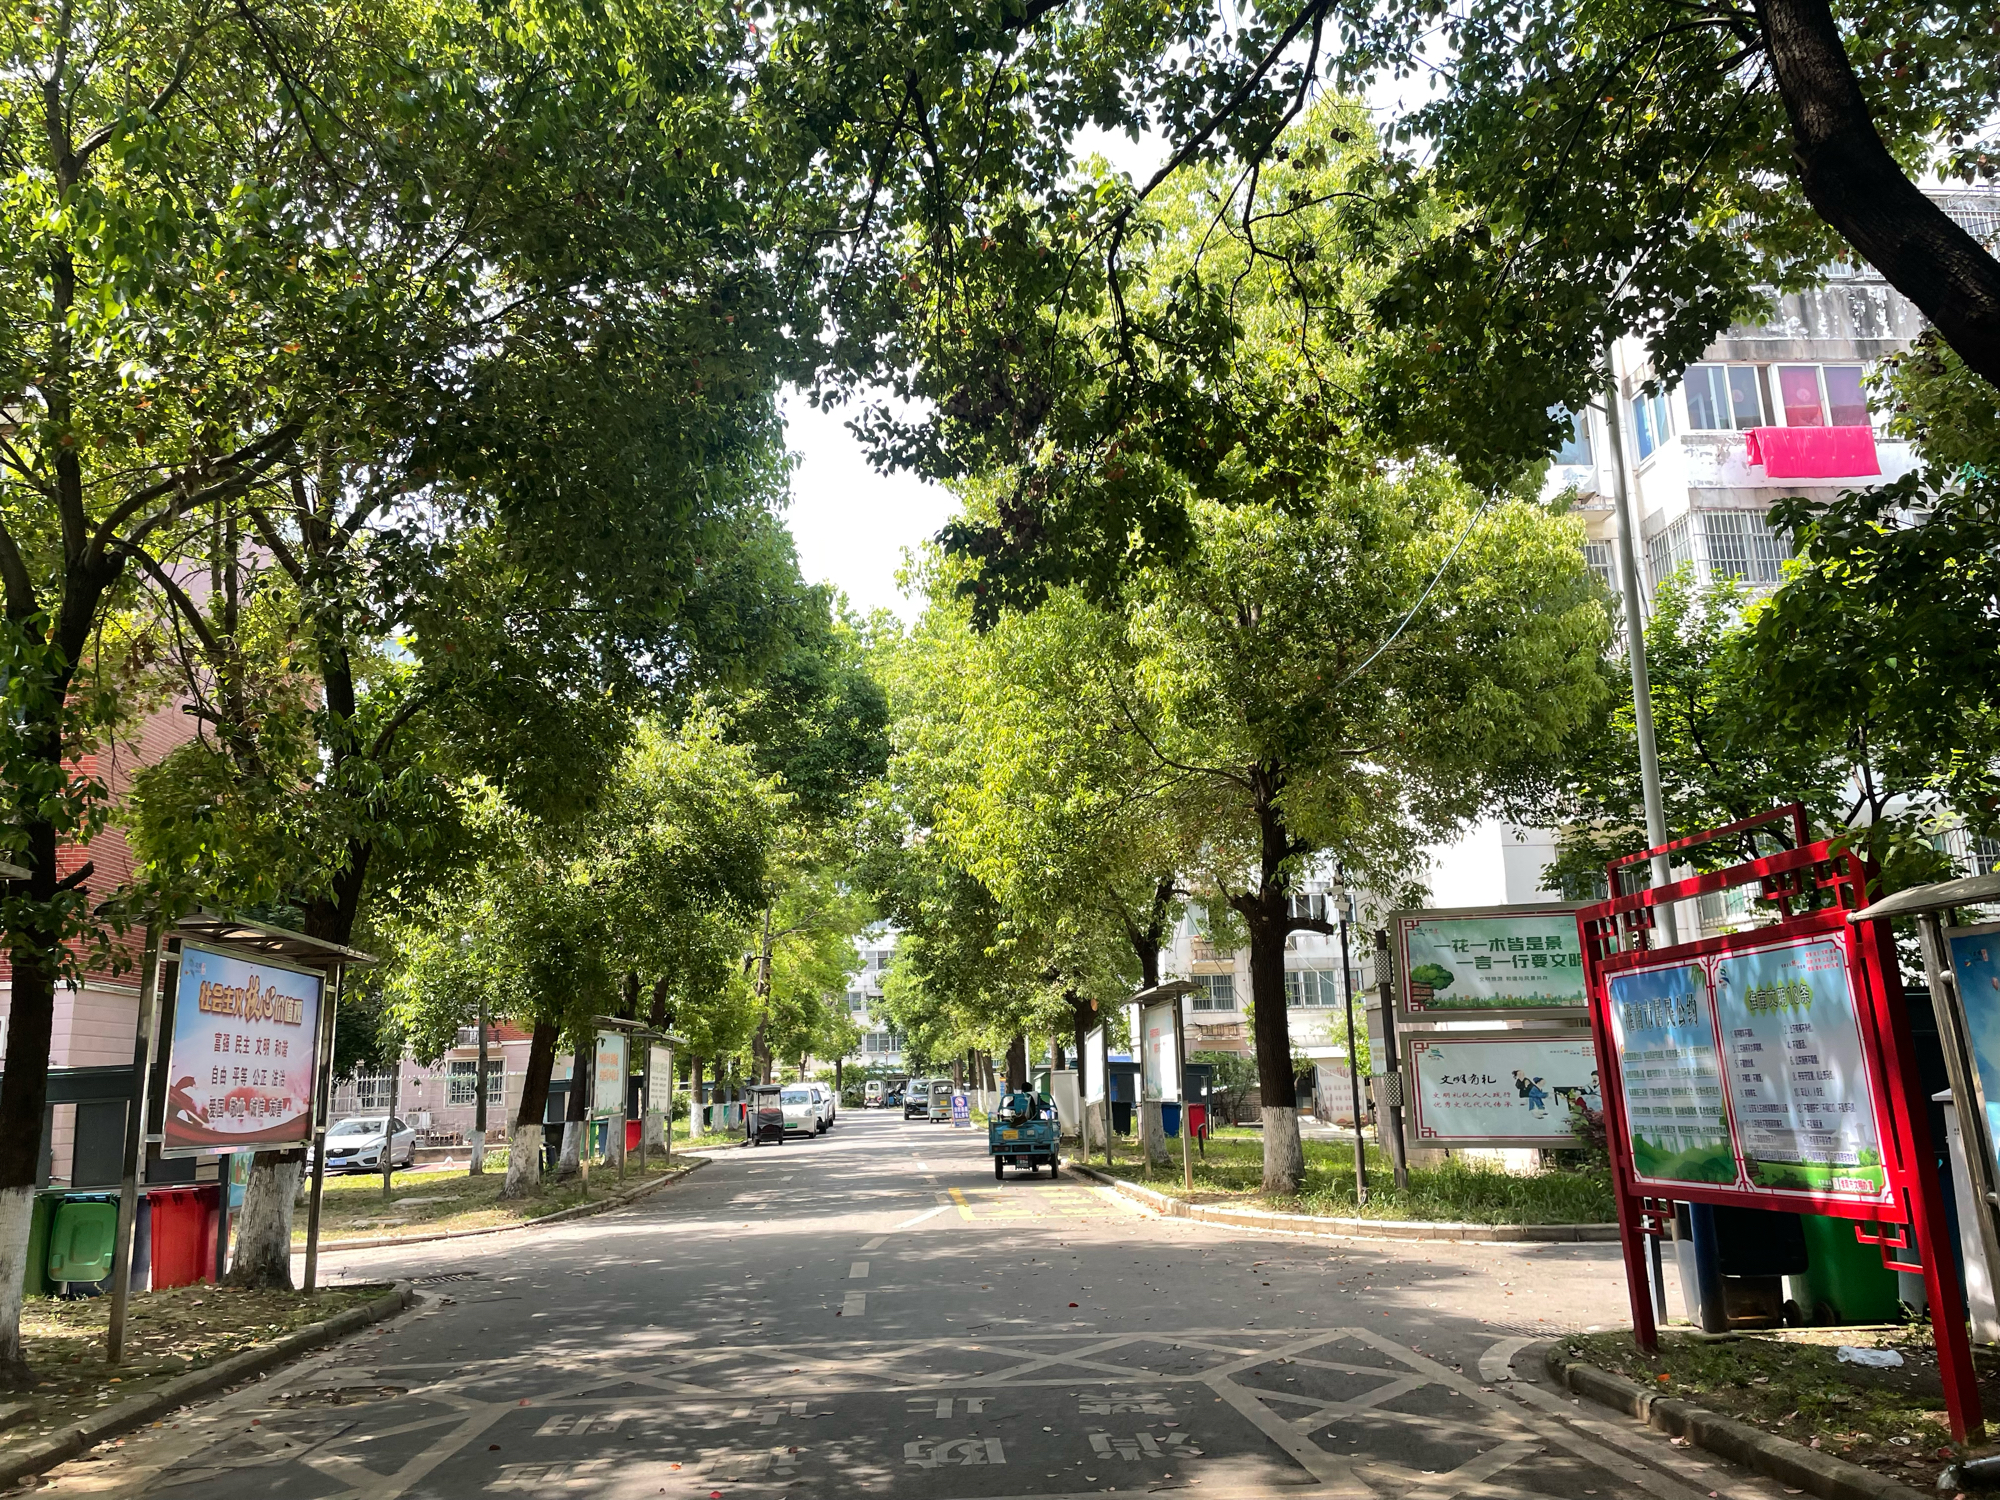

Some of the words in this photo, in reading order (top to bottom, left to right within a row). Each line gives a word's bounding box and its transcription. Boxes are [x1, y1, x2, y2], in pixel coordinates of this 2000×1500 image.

[1433, 935, 1563, 953] 一花一木皆是景
[199, 975, 304, 1026] 社会主义核心价值观
[1623, 992, 1699, 1035] 淮南市居民公约
[213, 1032, 230, 1053] 富强
[234, 1035, 250, 1054] 民主
[254, 1037, 271, 1056] 文明
[274, 1039, 289, 1058] 和谐
[211, 1065, 227, 1085] 自由
[232, 1066, 248, 1087] 平等
[252, 1068, 268, 1086] 公正
[271, 1069, 286, 1087] 法治
[1439, 1073, 1497, 1086] 文明有礼
[1432, 1091, 1512, 1099] 文明礼仪人人践行
[1432, 1101, 1513, 1109] 优秀文化代代传承
[208, 1096, 225, 1118] 爱国
[229, 1097, 246, 1118] 敬业
[249, 1097, 266, 1118] 诚信
[268, 1097, 284, 1118] 友善
